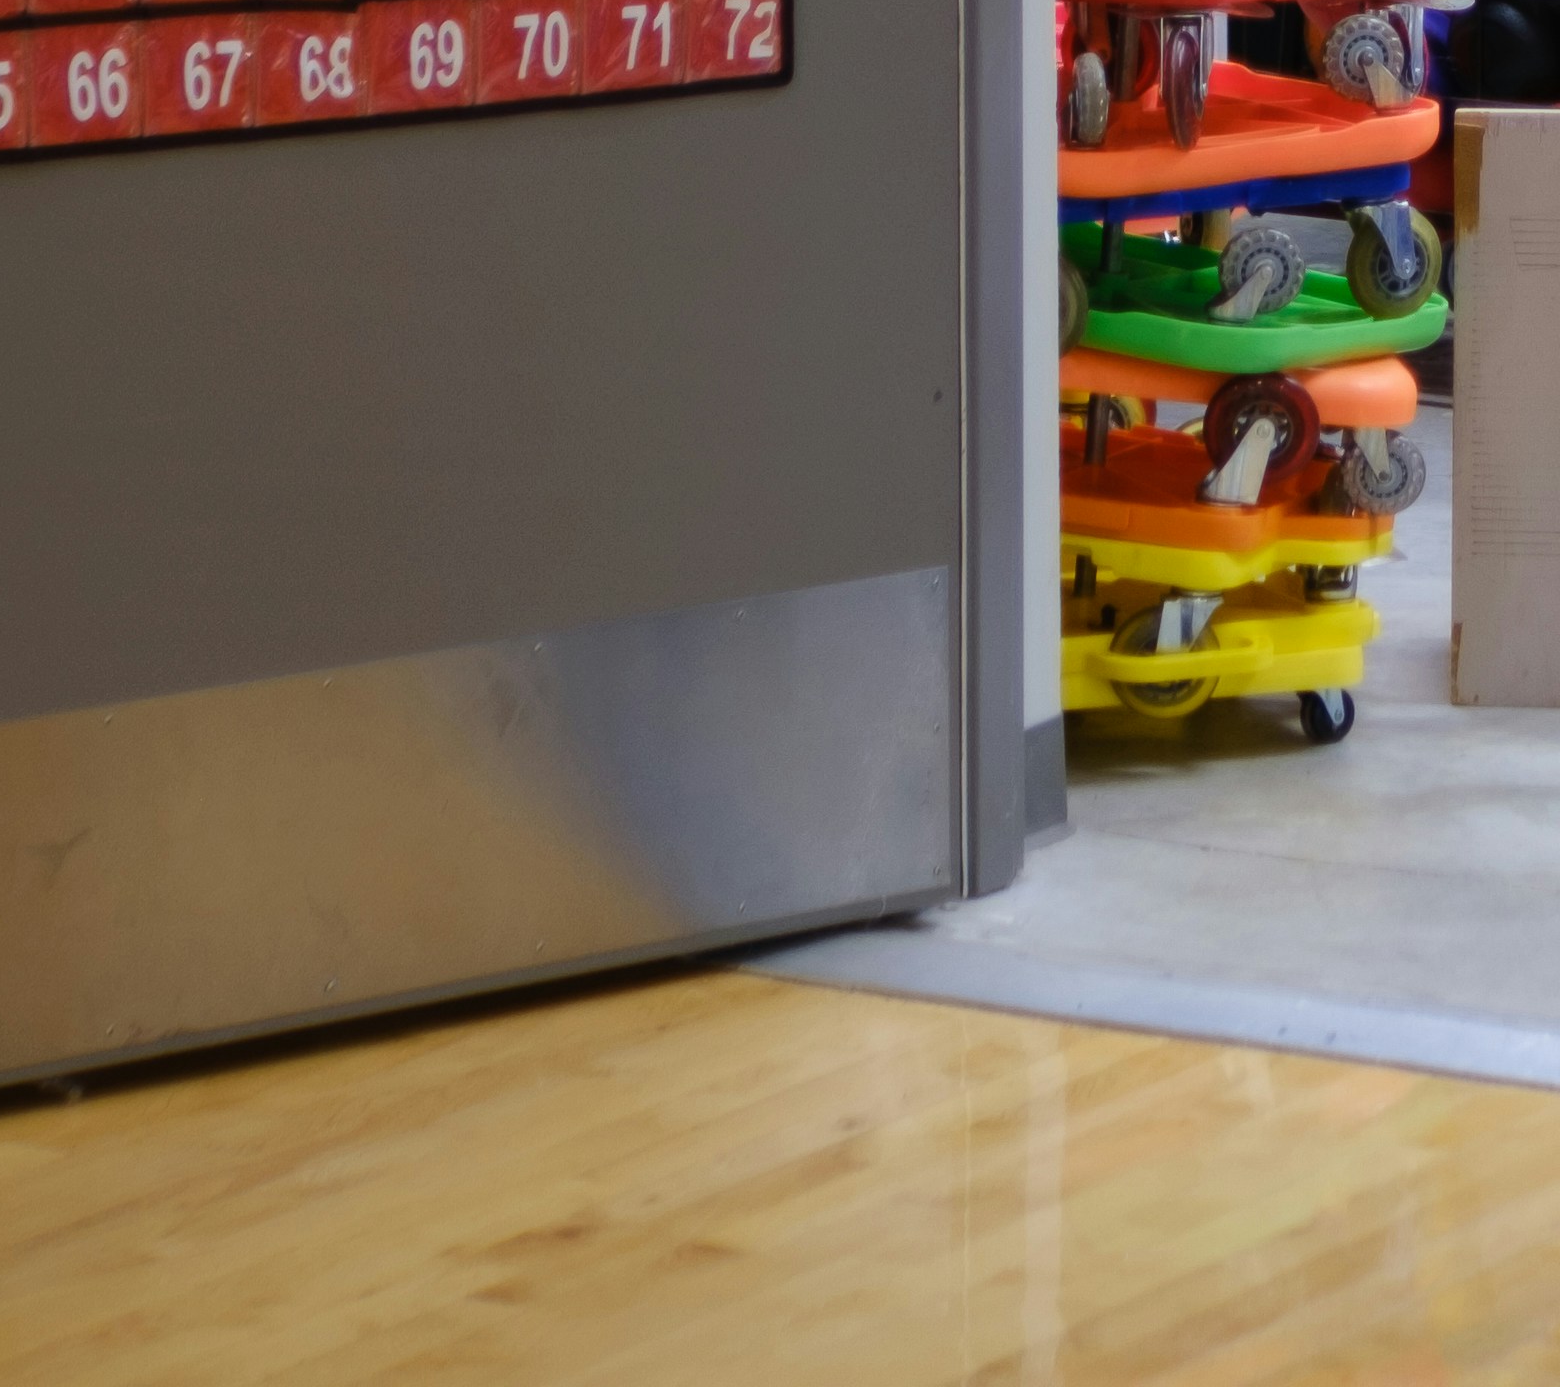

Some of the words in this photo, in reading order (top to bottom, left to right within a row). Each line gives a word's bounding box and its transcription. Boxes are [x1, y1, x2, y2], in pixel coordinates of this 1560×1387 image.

[68, 48, 129, 121] 66
[183, 39, 243, 111] 67
[300, 36, 354, 101] 68
[409, 20, 466, 91] 69
[514, 11, 569, 80] 70
[622, 5, 675, 69] 71
